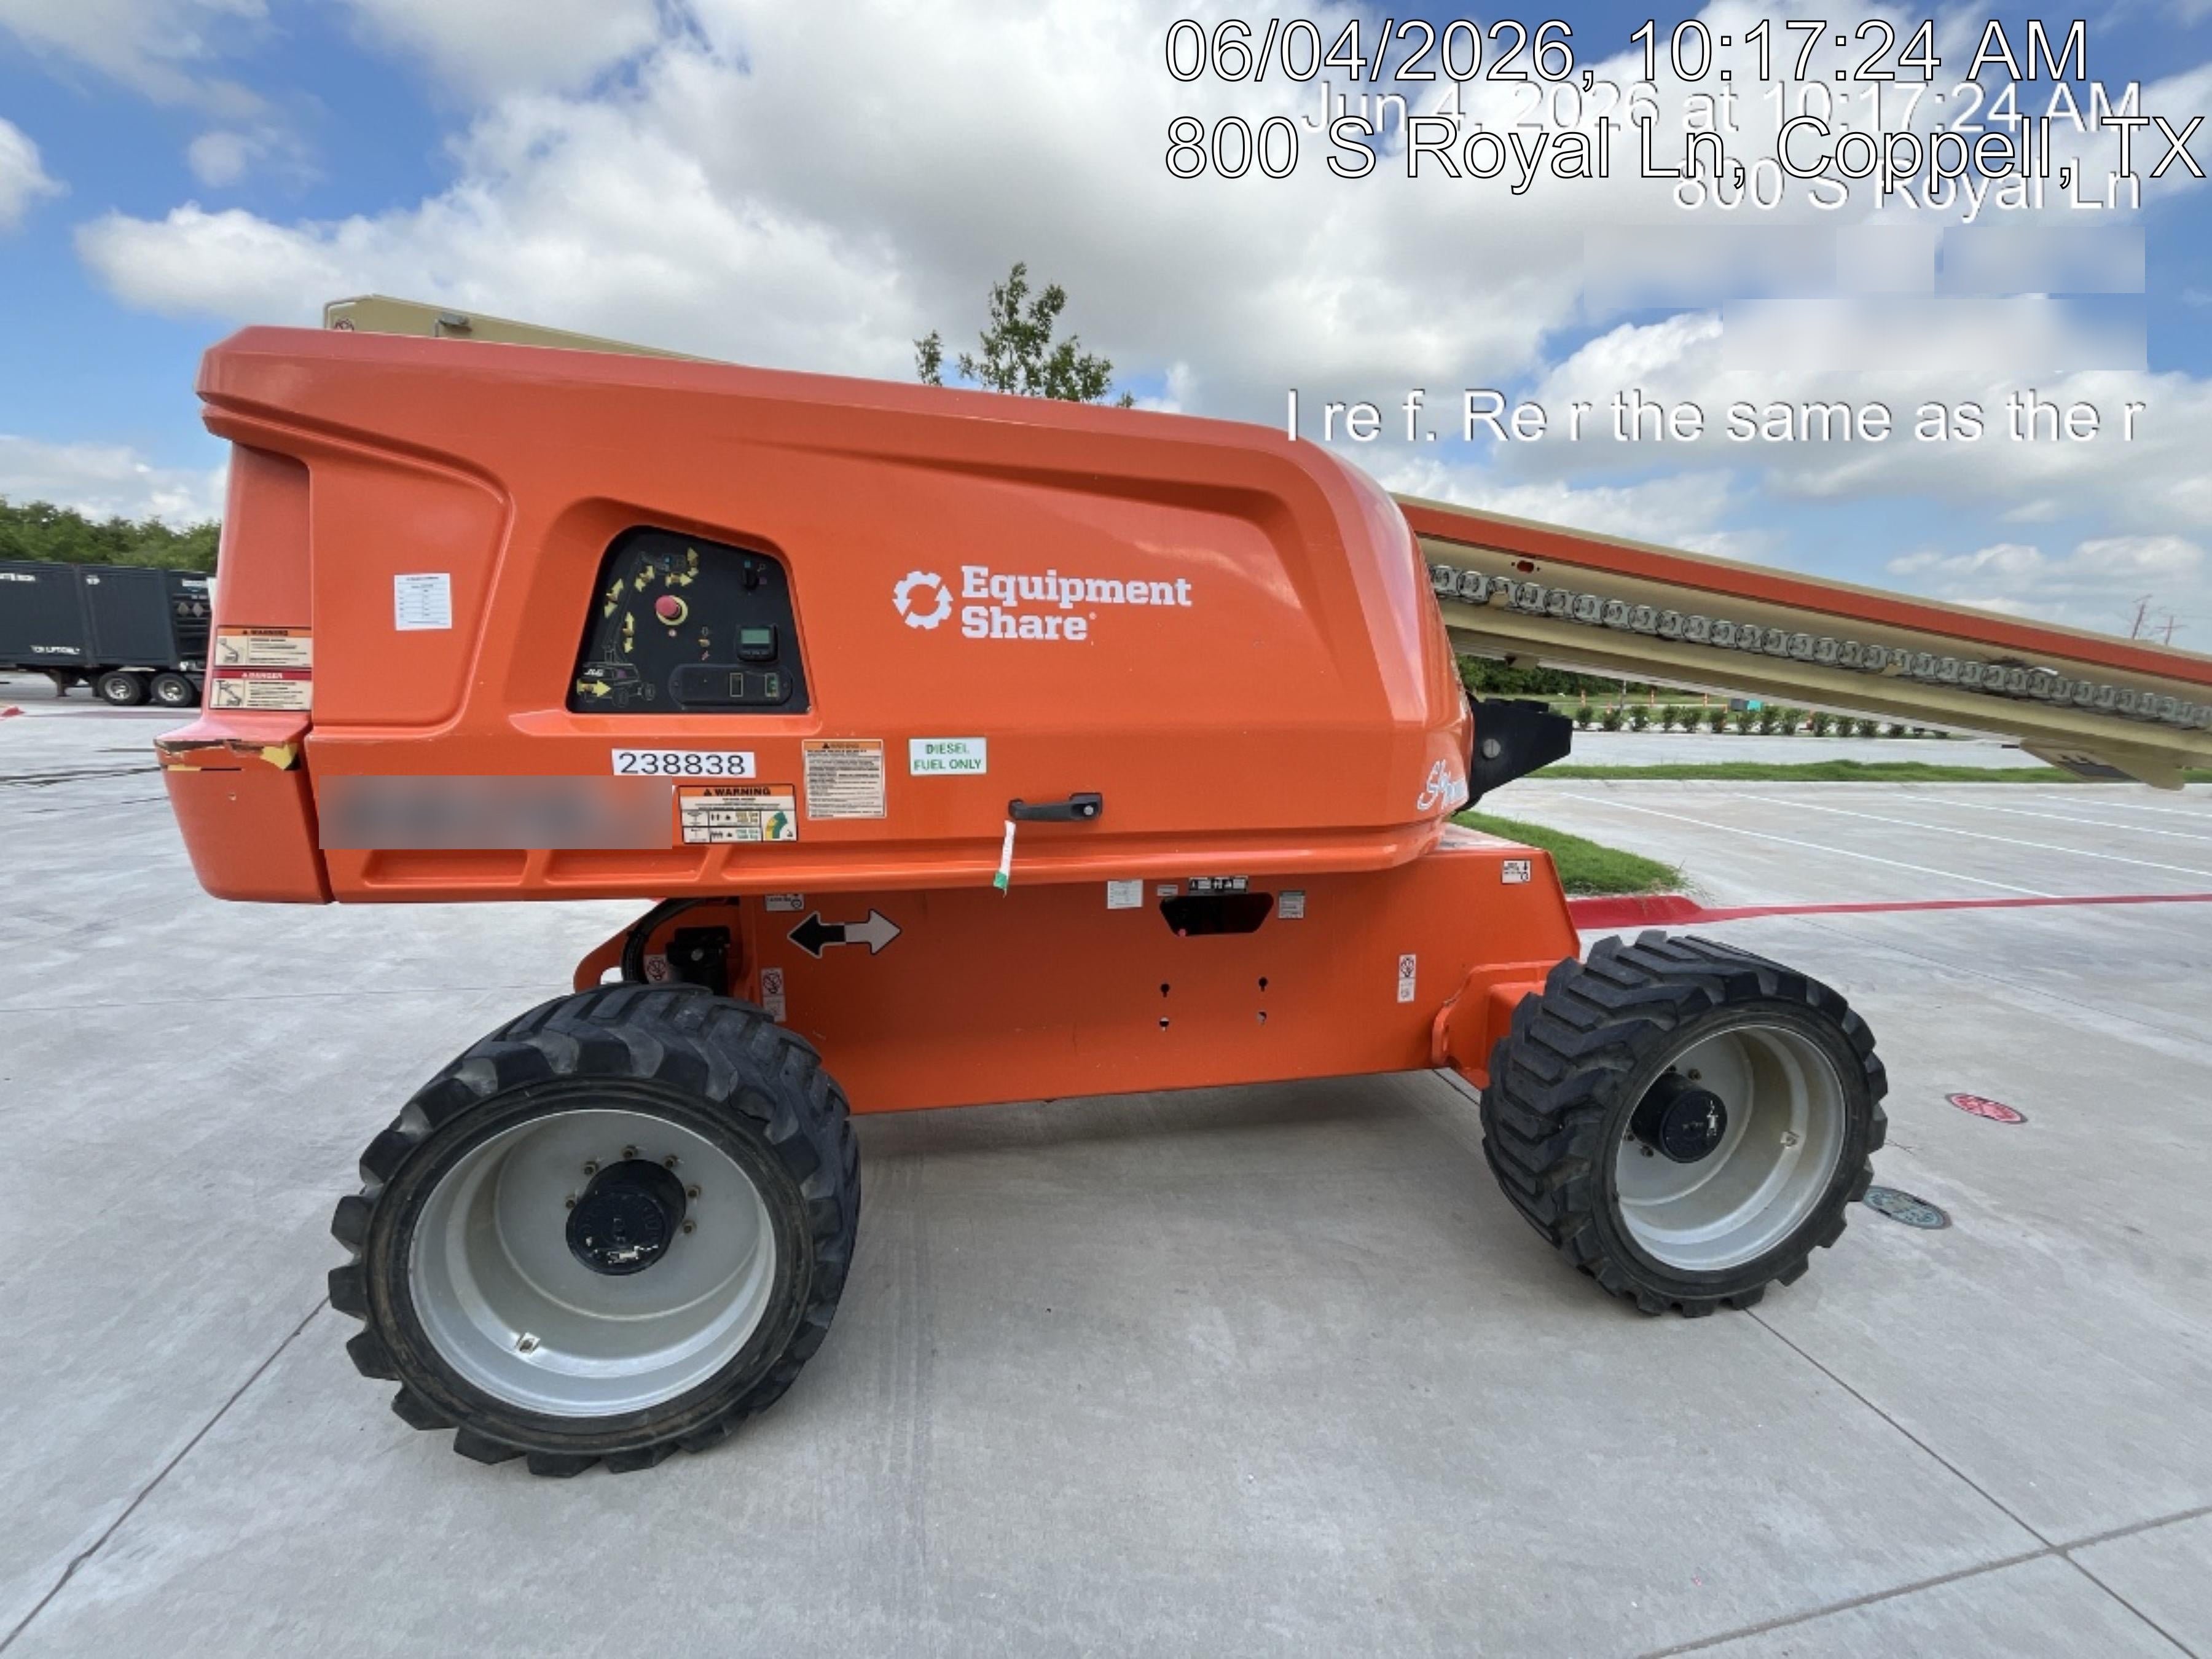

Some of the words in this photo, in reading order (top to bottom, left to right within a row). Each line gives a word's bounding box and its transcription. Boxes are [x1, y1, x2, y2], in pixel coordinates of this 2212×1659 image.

[962, 565, 1193, 609] Equipment
[925, 743, 970, 755] DIESEL
[619, 752, 745, 775] 238838
[913, 759, 946, 771] FUEL
[949, 759, 982, 769] ONLY
[714, 788, 771, 796] WARNING
